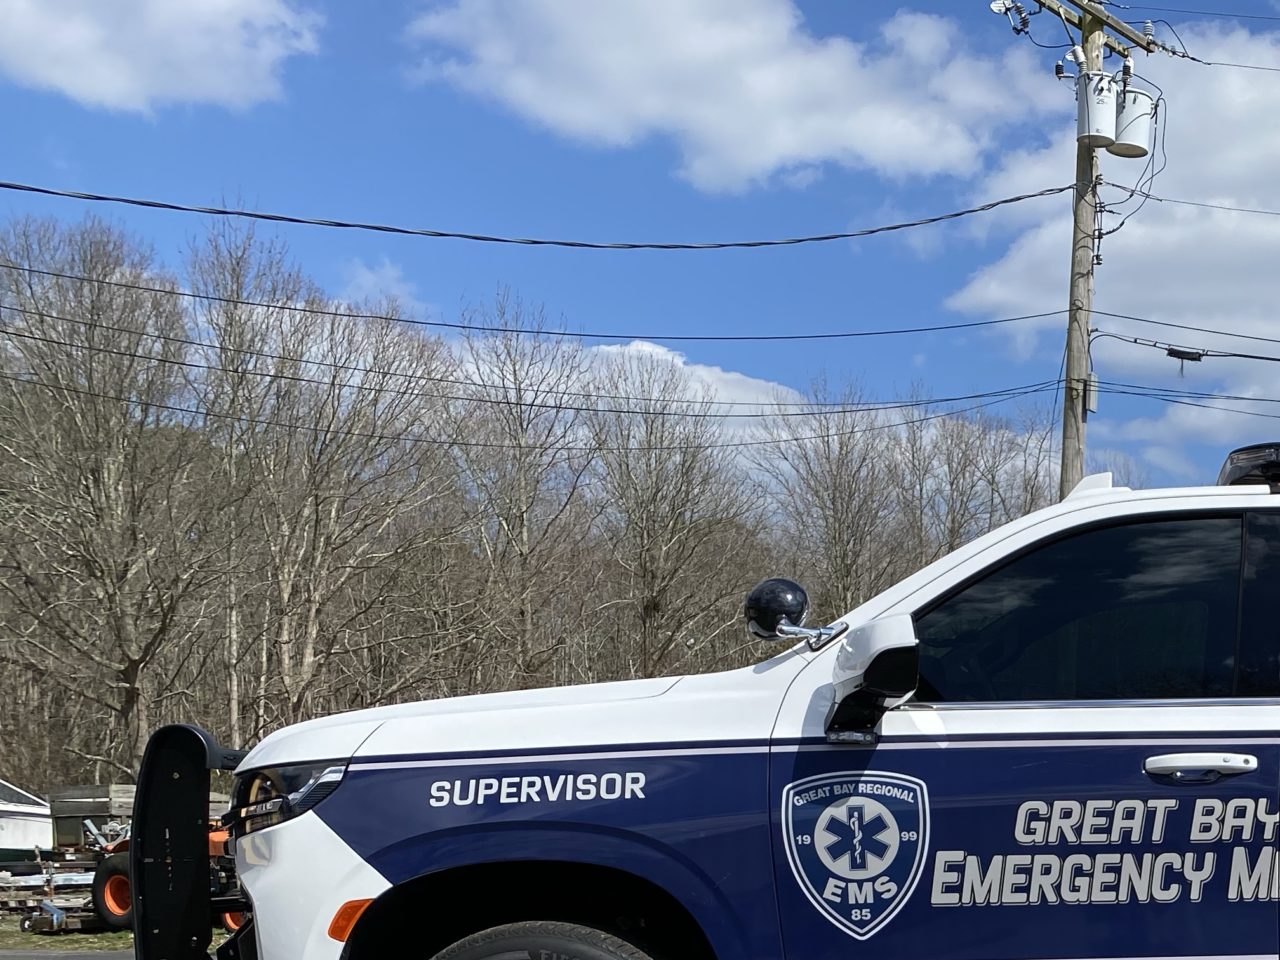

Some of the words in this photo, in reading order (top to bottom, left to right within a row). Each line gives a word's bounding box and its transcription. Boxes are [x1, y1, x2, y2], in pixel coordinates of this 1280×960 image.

[429, 772, 646, 807] SUPERVISOR
[793, 786, 831, 807] GREAT
[833, 783, 855, 794] BAY
[858, 783, 915, 803] REGIONAL
[1014, 799, 1178, 844] GREAT
[796, 834, 811, 845] 19
[901, 831, 917, 841] 99
[822, 875, 898, 904] EMS
[931, 850, 1216, 906] EMERGENCY
[851, 909, 871, 921] 85
